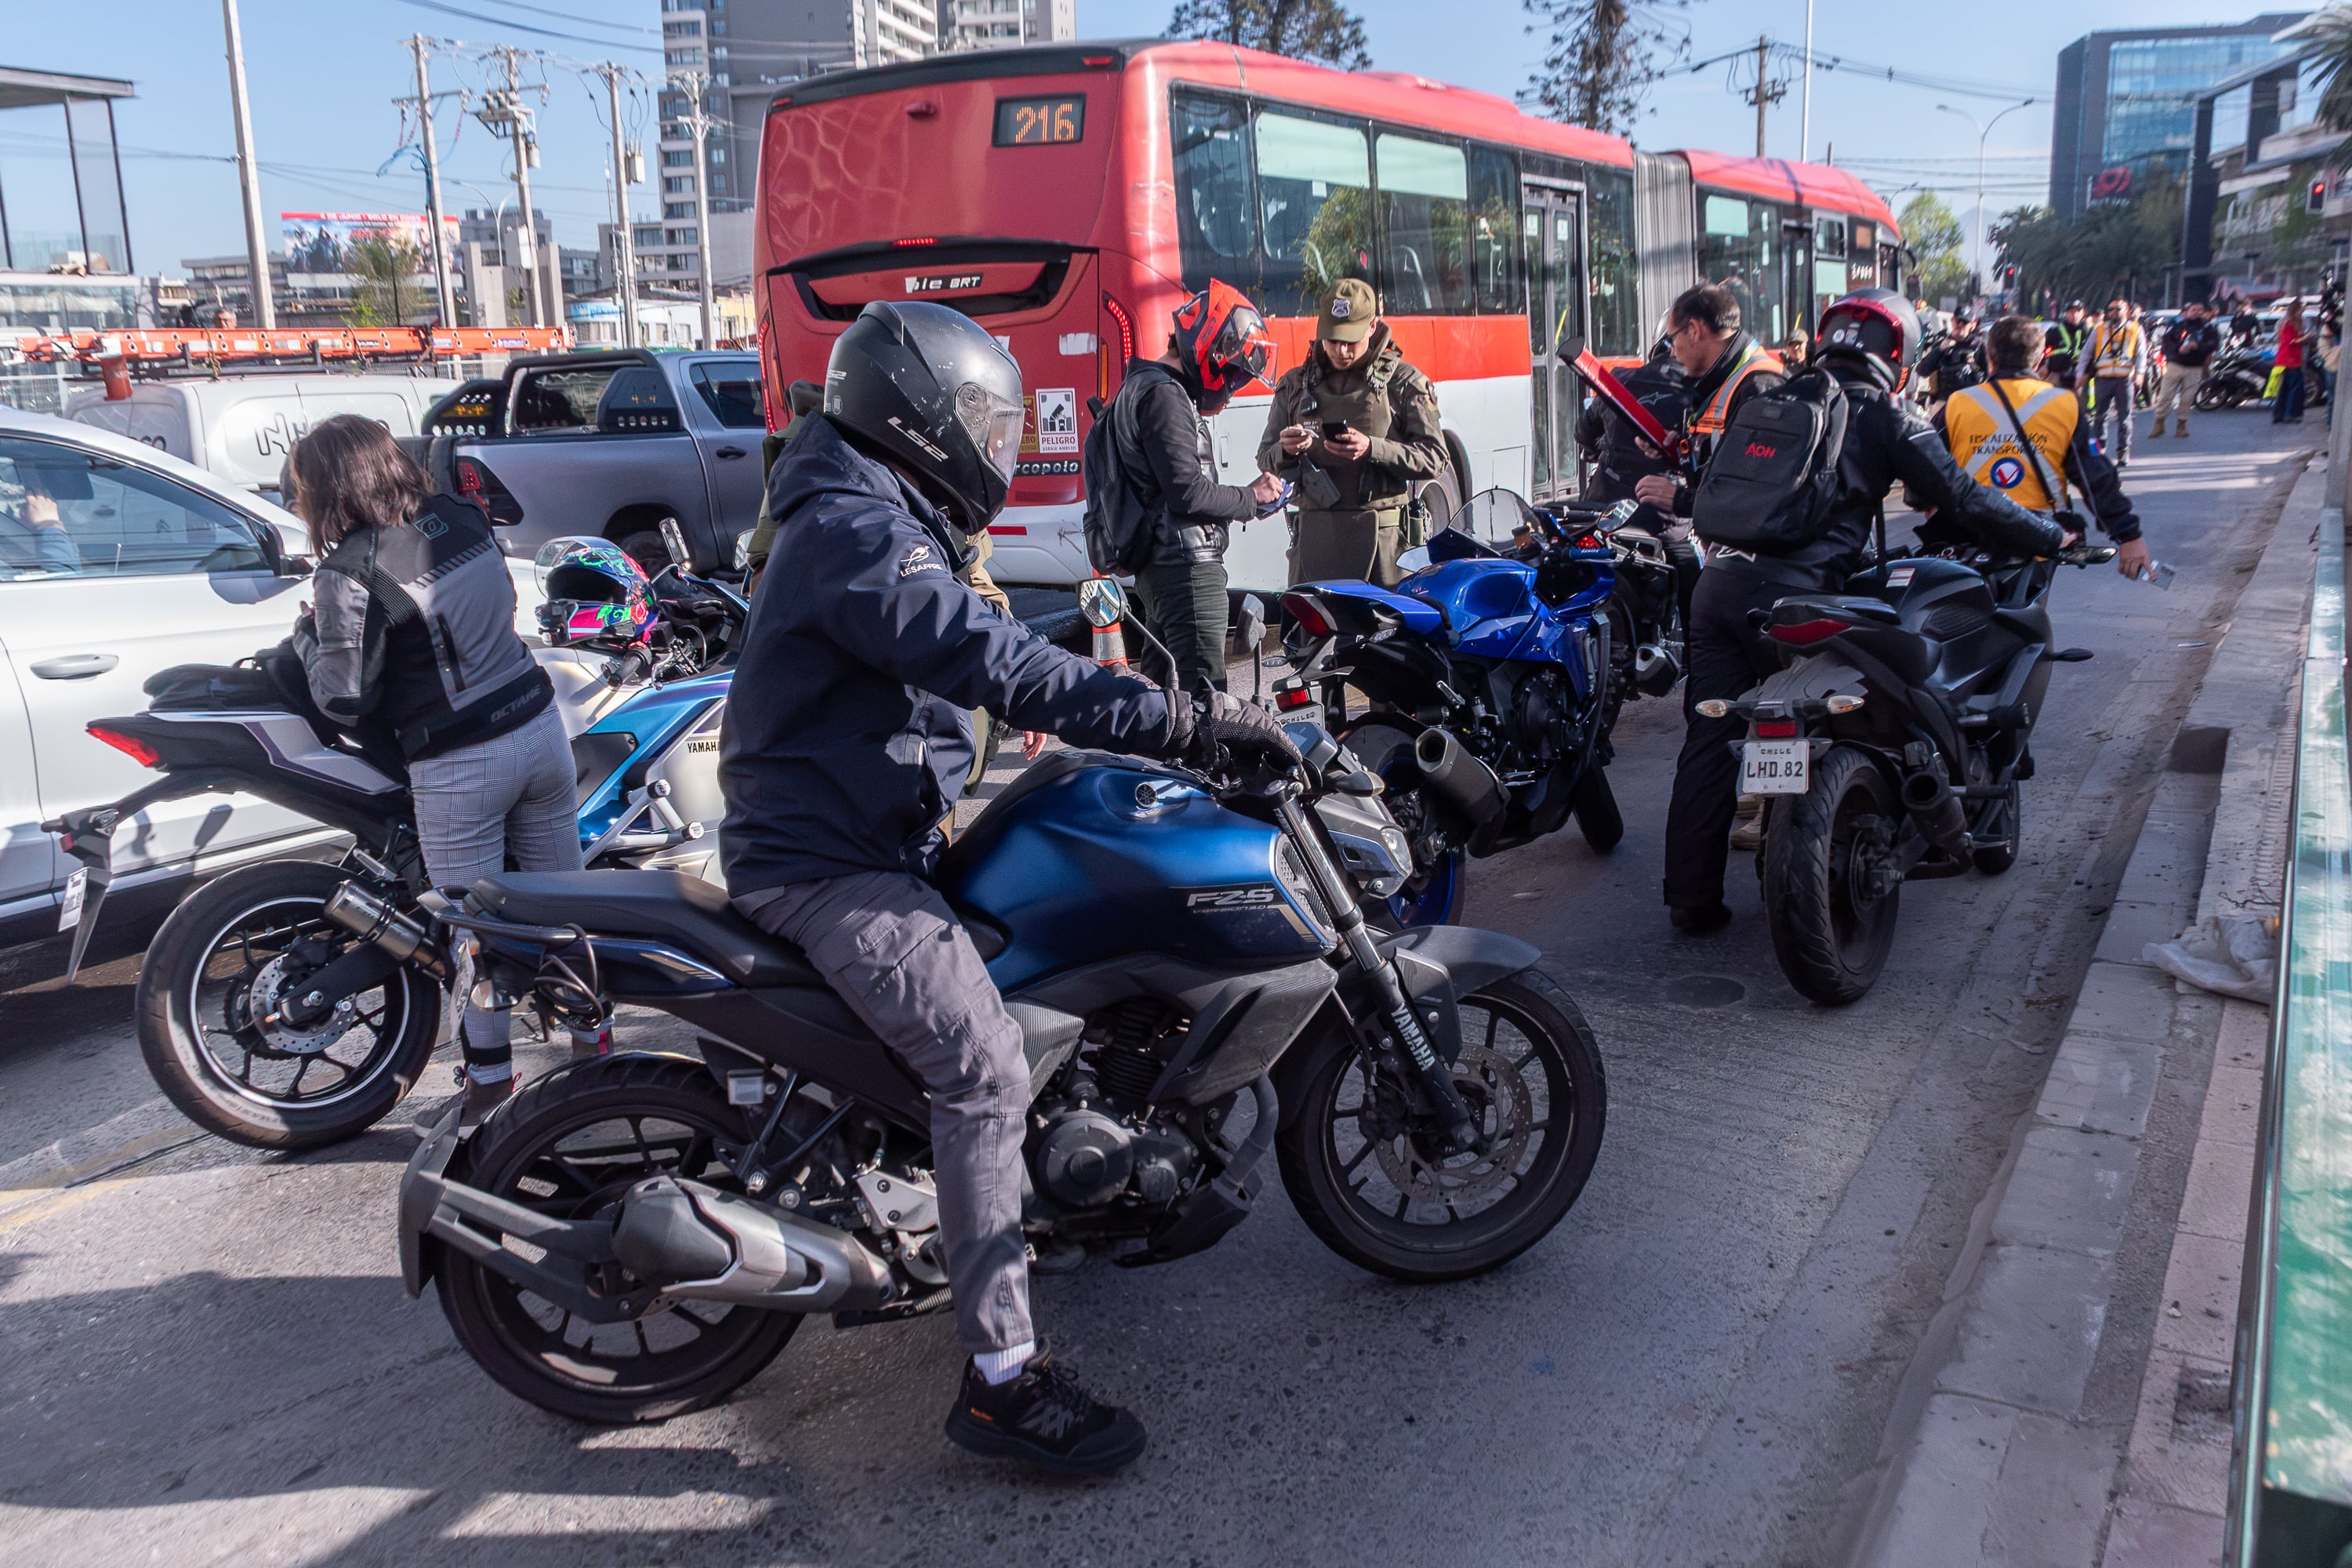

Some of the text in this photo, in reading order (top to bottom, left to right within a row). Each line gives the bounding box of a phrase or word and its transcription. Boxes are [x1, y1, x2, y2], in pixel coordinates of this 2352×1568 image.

[1015, 103, 1074, 143] 216
[949, 277, 981, 289] BRT
[887, 416, 949, 463] LS2
[1744, 442, 1777, 459] AON
[1014, 460, 1079, 475] rcopolo
[899, 563, 943, 578] LESAFFRE
[490, 683, 541, 722] OCTANE
[1286, 713, 1311, 724] CHILE
[1746, 760, 1803, 779] LHD.82
[1391, 1002, 1436, 1073] YAMAHA
